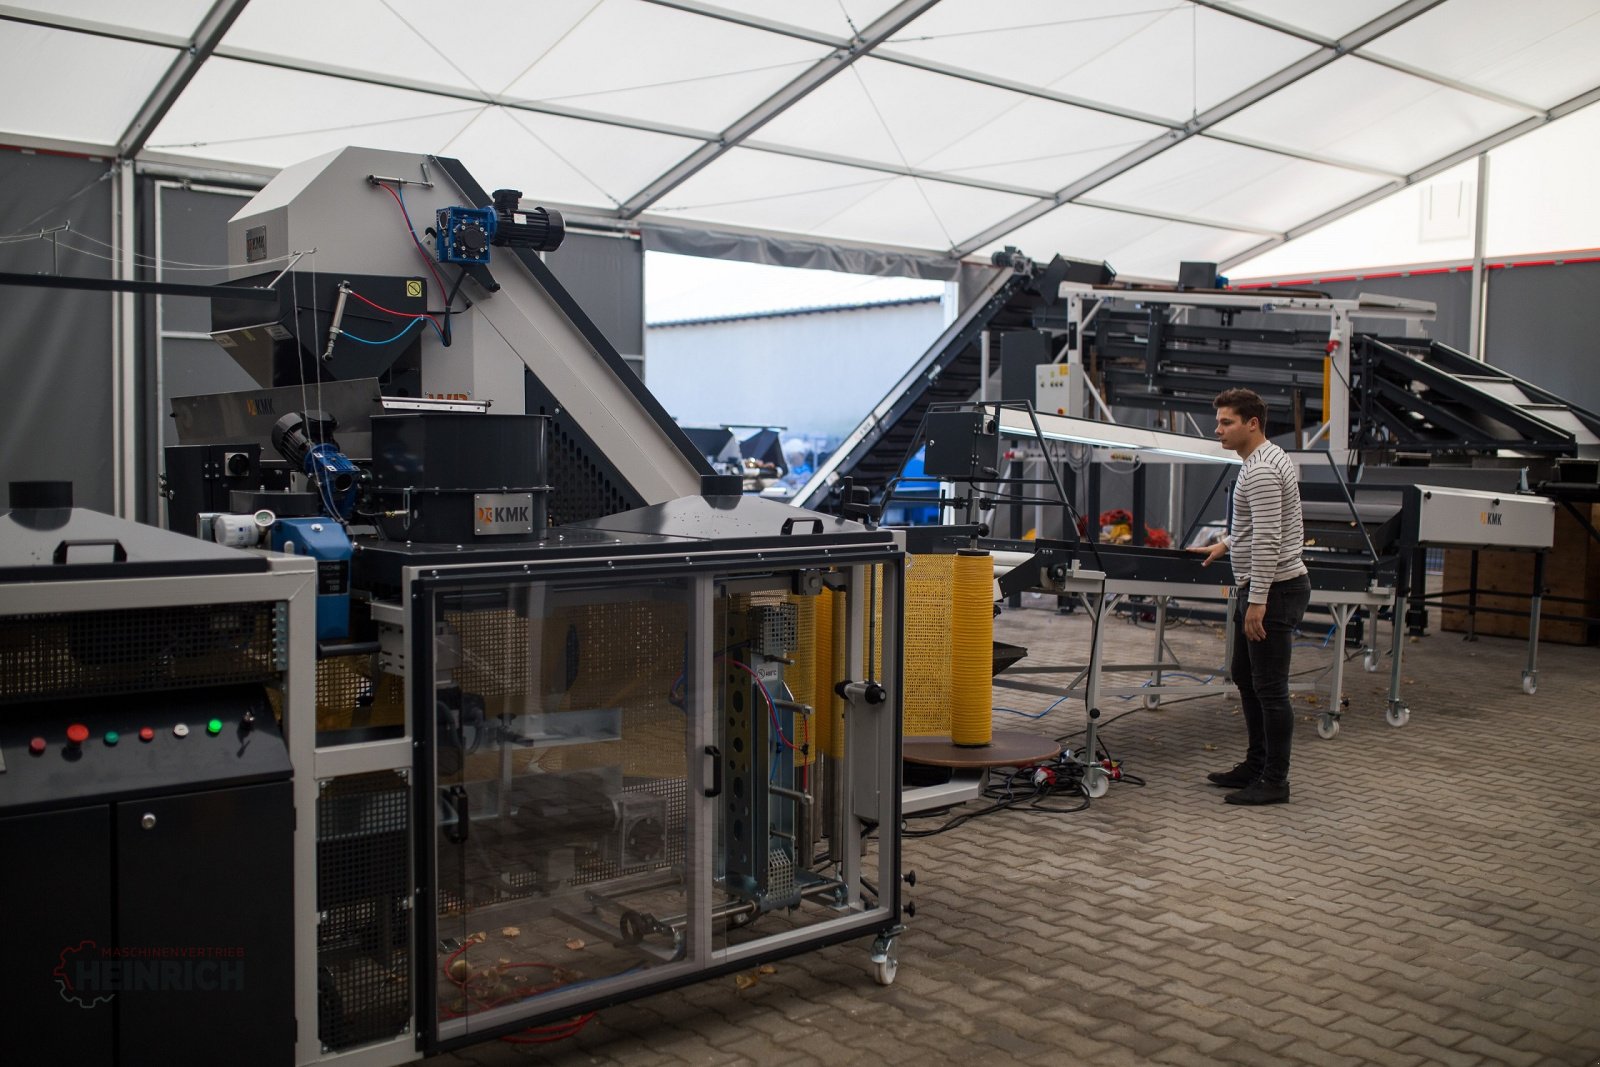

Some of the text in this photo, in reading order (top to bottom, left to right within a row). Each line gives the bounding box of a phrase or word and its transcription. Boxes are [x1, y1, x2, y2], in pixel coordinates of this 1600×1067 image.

[255, 398, 276, 416] KMK
[495, 506, 529, 522] KMK
[1487, 511, 1503, 526] KMK
